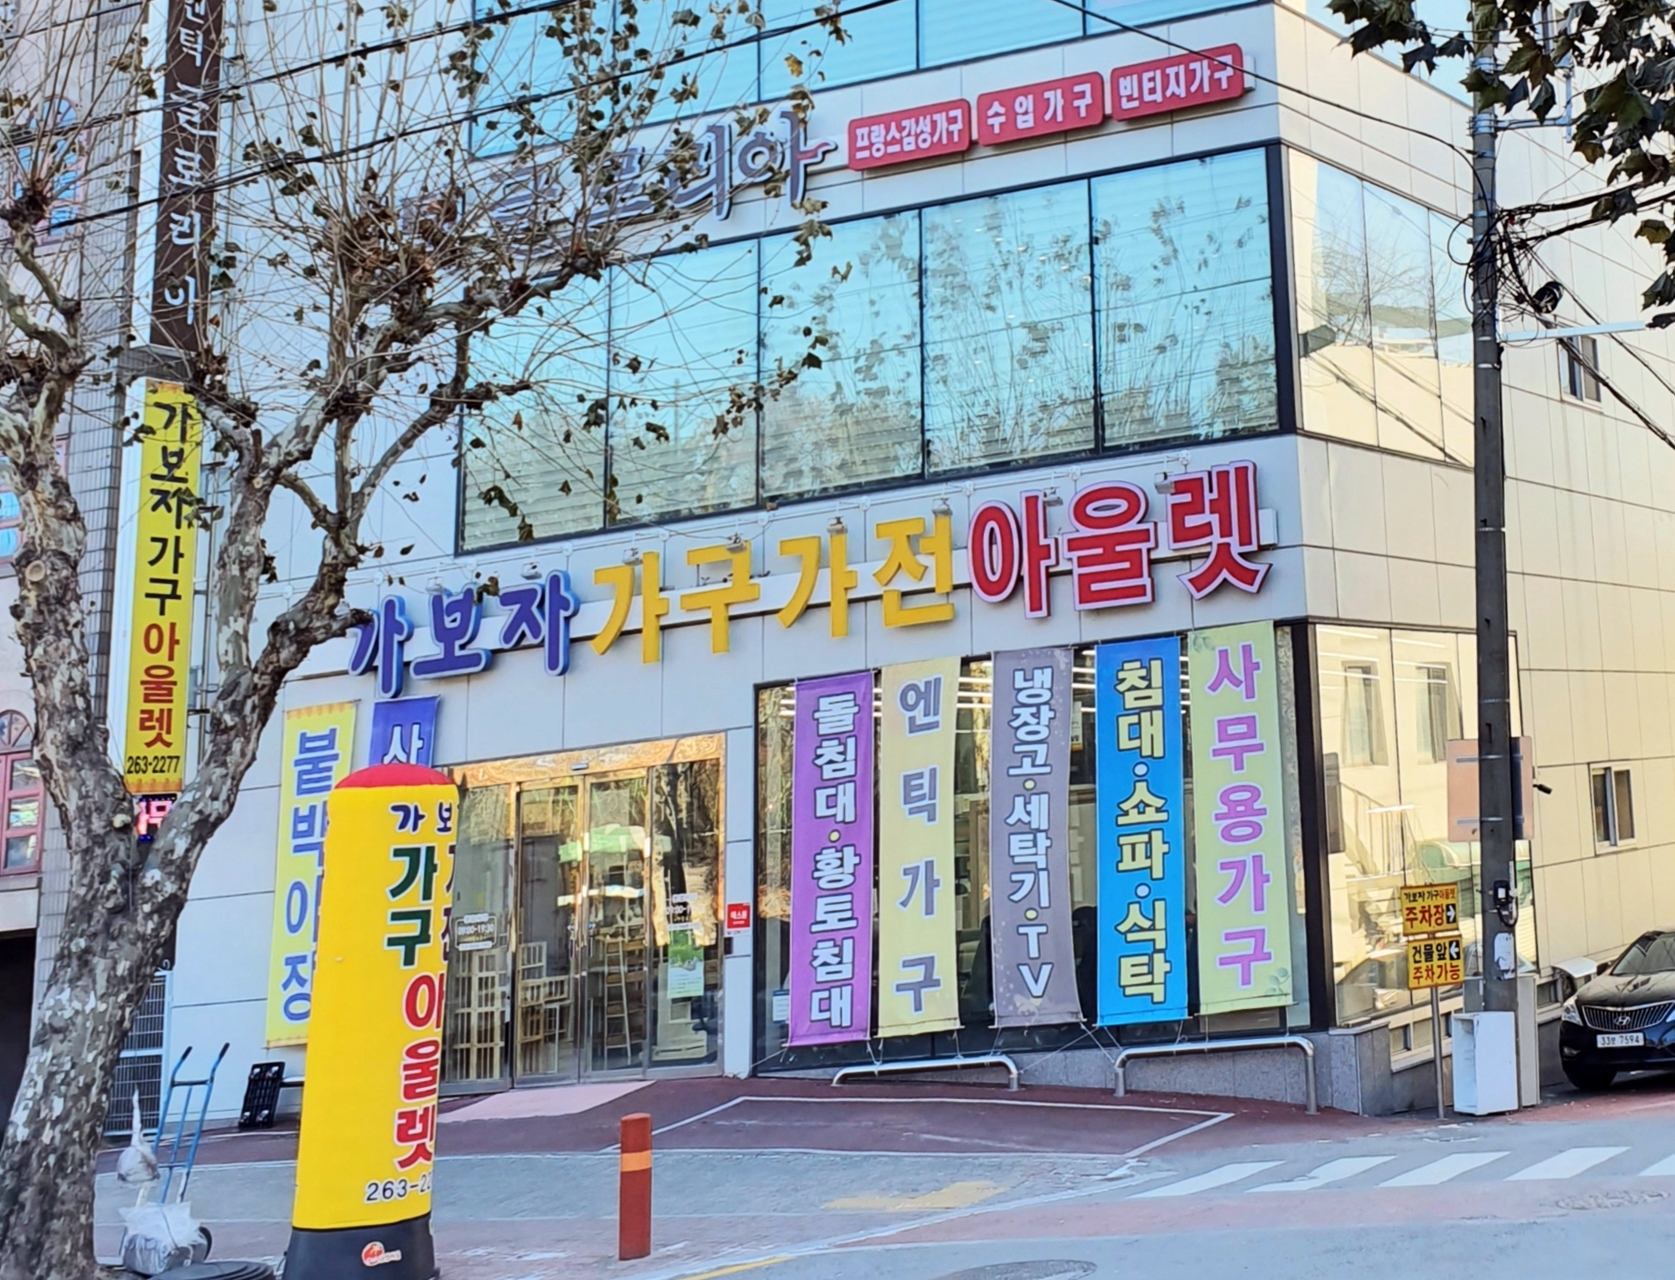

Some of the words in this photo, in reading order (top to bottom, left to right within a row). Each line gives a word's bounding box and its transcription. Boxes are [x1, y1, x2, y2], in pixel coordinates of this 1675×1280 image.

[1118, 54, 1234, 109] 빈티지가구
[986, 83, 1093, 134] 수입가구
[855, 109, 963, 159] 프랑스감성가구
[968, 460, 1271, 620] 아울렛
[126, 756, 181, 775] 263-2277
[1206, 642, 1274, 989] 사무용가구
[1405, 903, 1445, 929] 주차장
[1412, 962, 1461, 985] 주차가능
